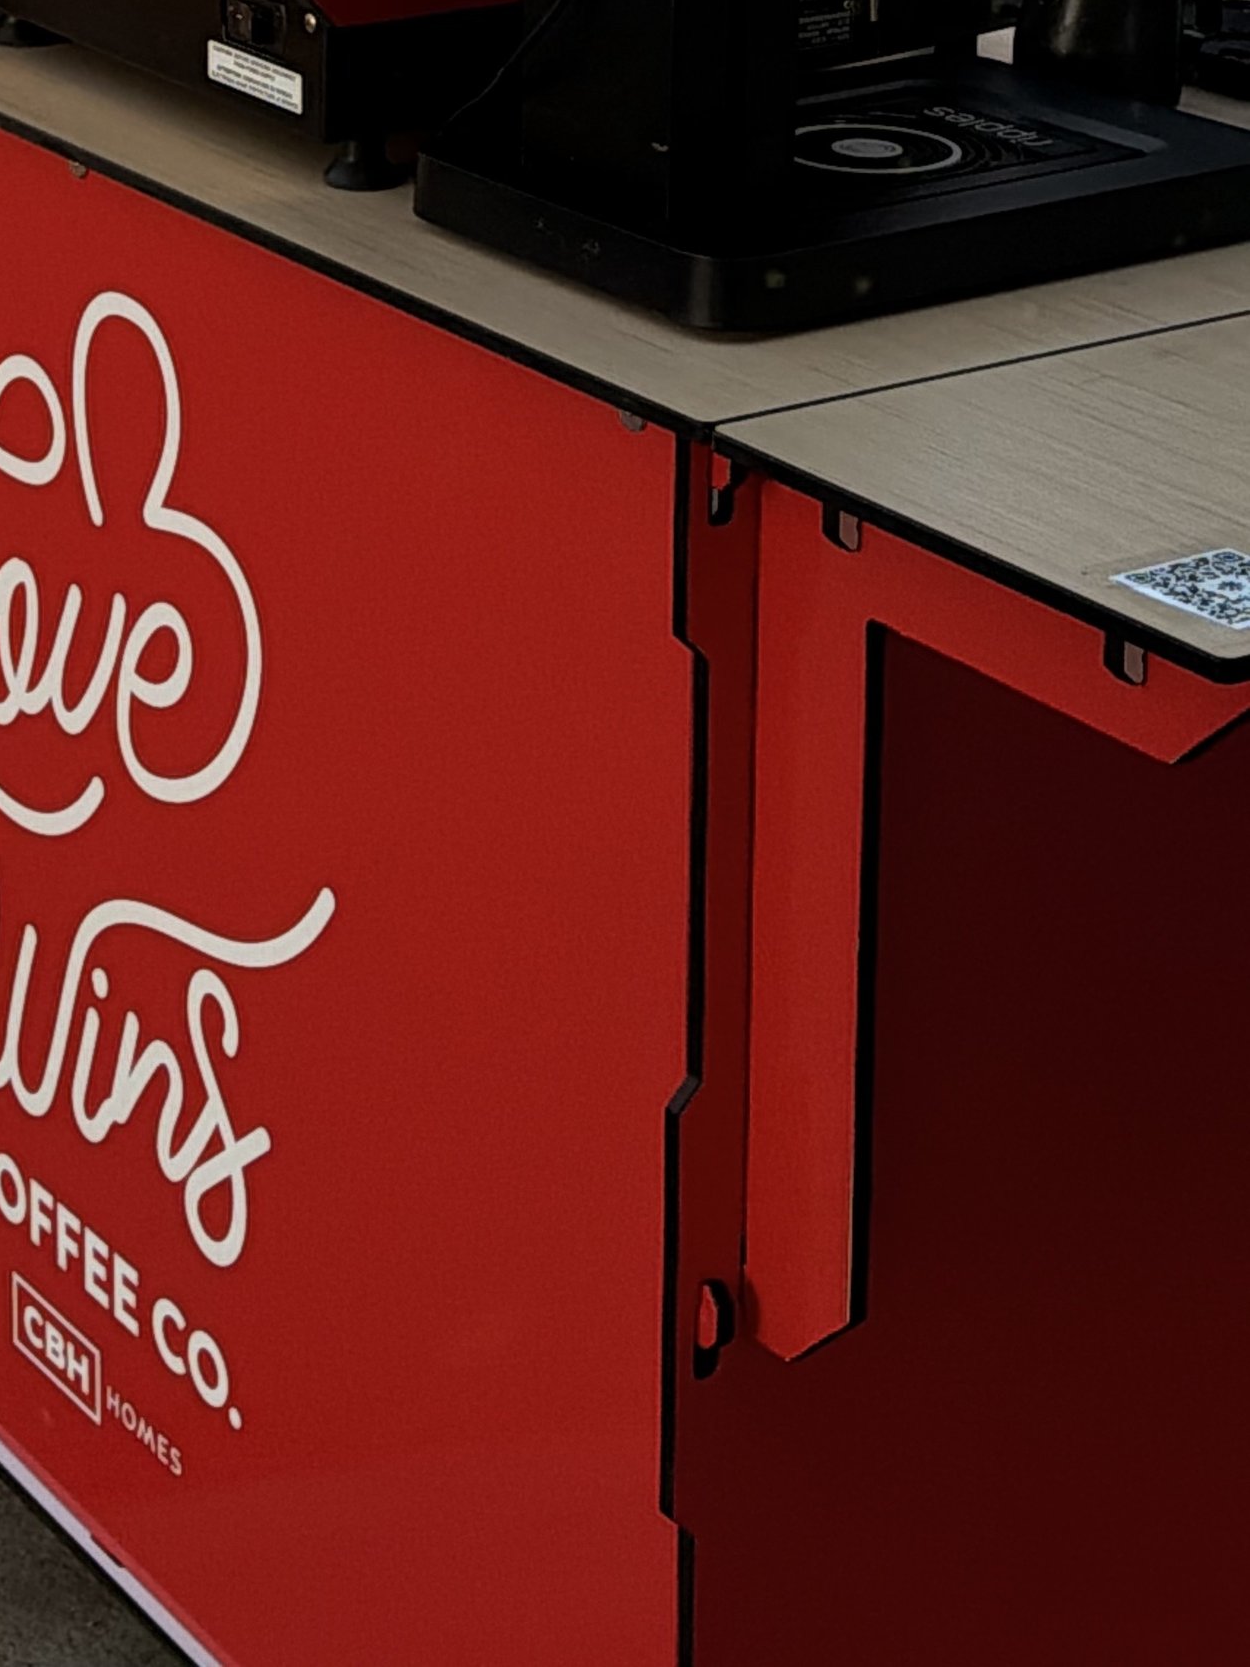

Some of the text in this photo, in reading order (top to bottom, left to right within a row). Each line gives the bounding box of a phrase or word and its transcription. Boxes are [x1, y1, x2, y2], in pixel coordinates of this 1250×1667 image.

[22, 1303, 184, 1478] CBH HOMES
[151, 1297, 243, 1430] CO.
